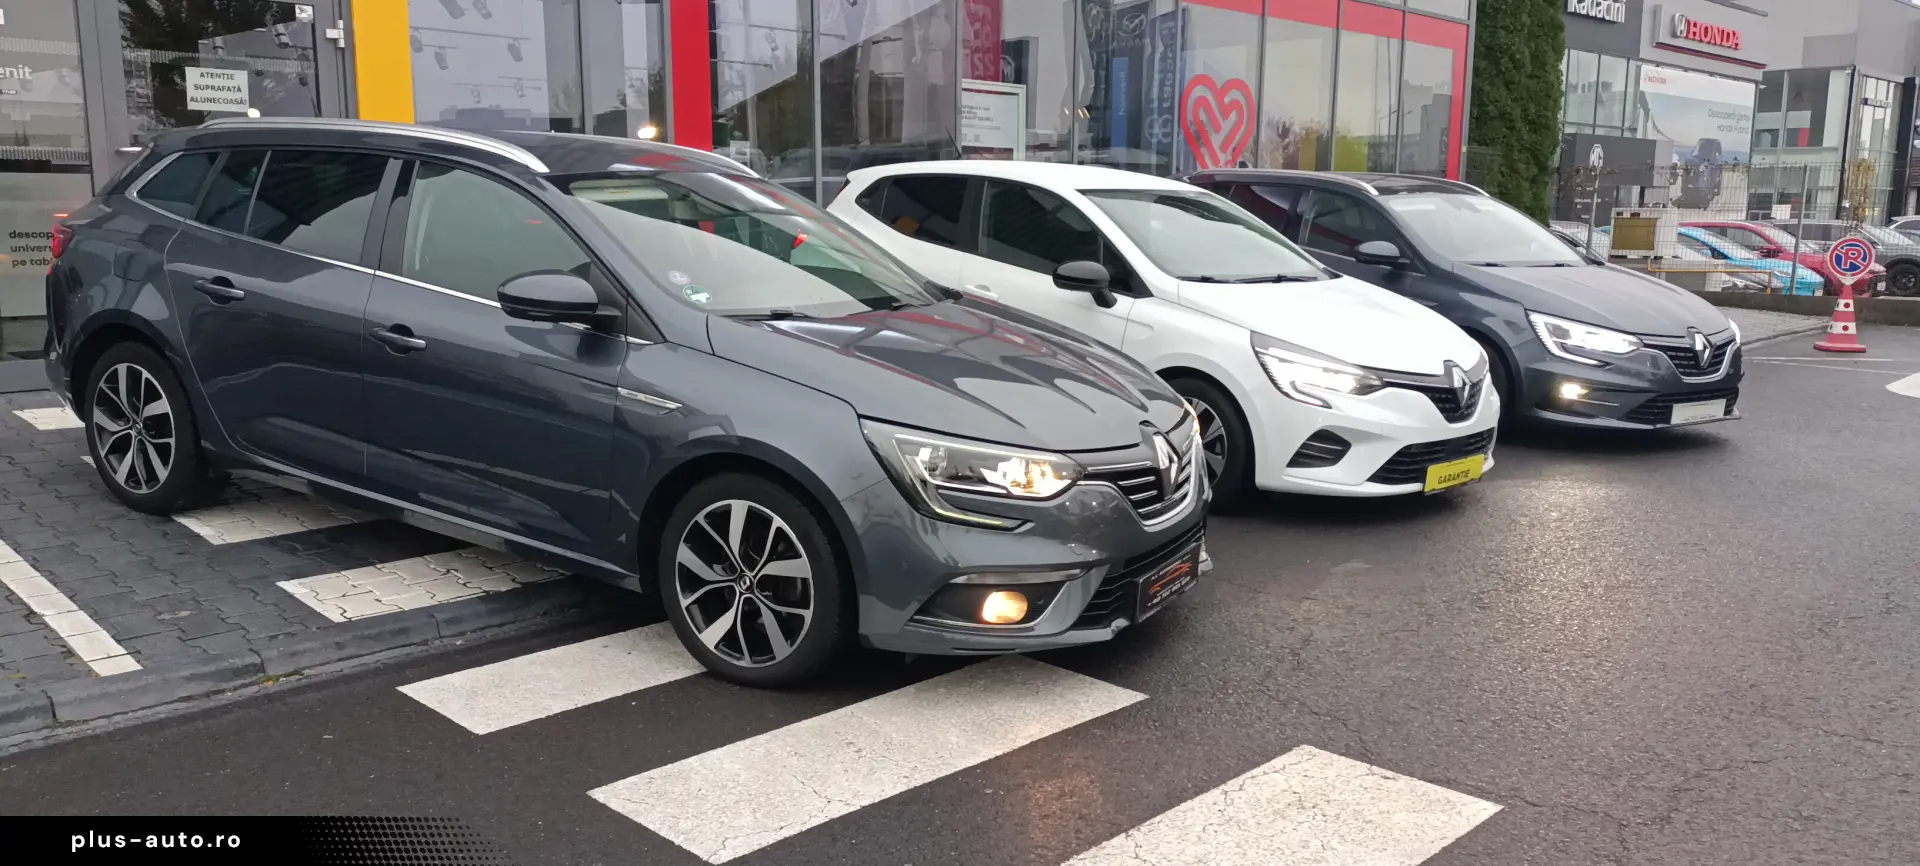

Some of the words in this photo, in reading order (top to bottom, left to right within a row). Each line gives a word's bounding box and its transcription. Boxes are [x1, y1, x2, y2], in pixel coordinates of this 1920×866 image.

[1686, 18, 1742, 50] HONDA
[9, 229, 53, 240] descop
[12, 259, 27, 268] pe
